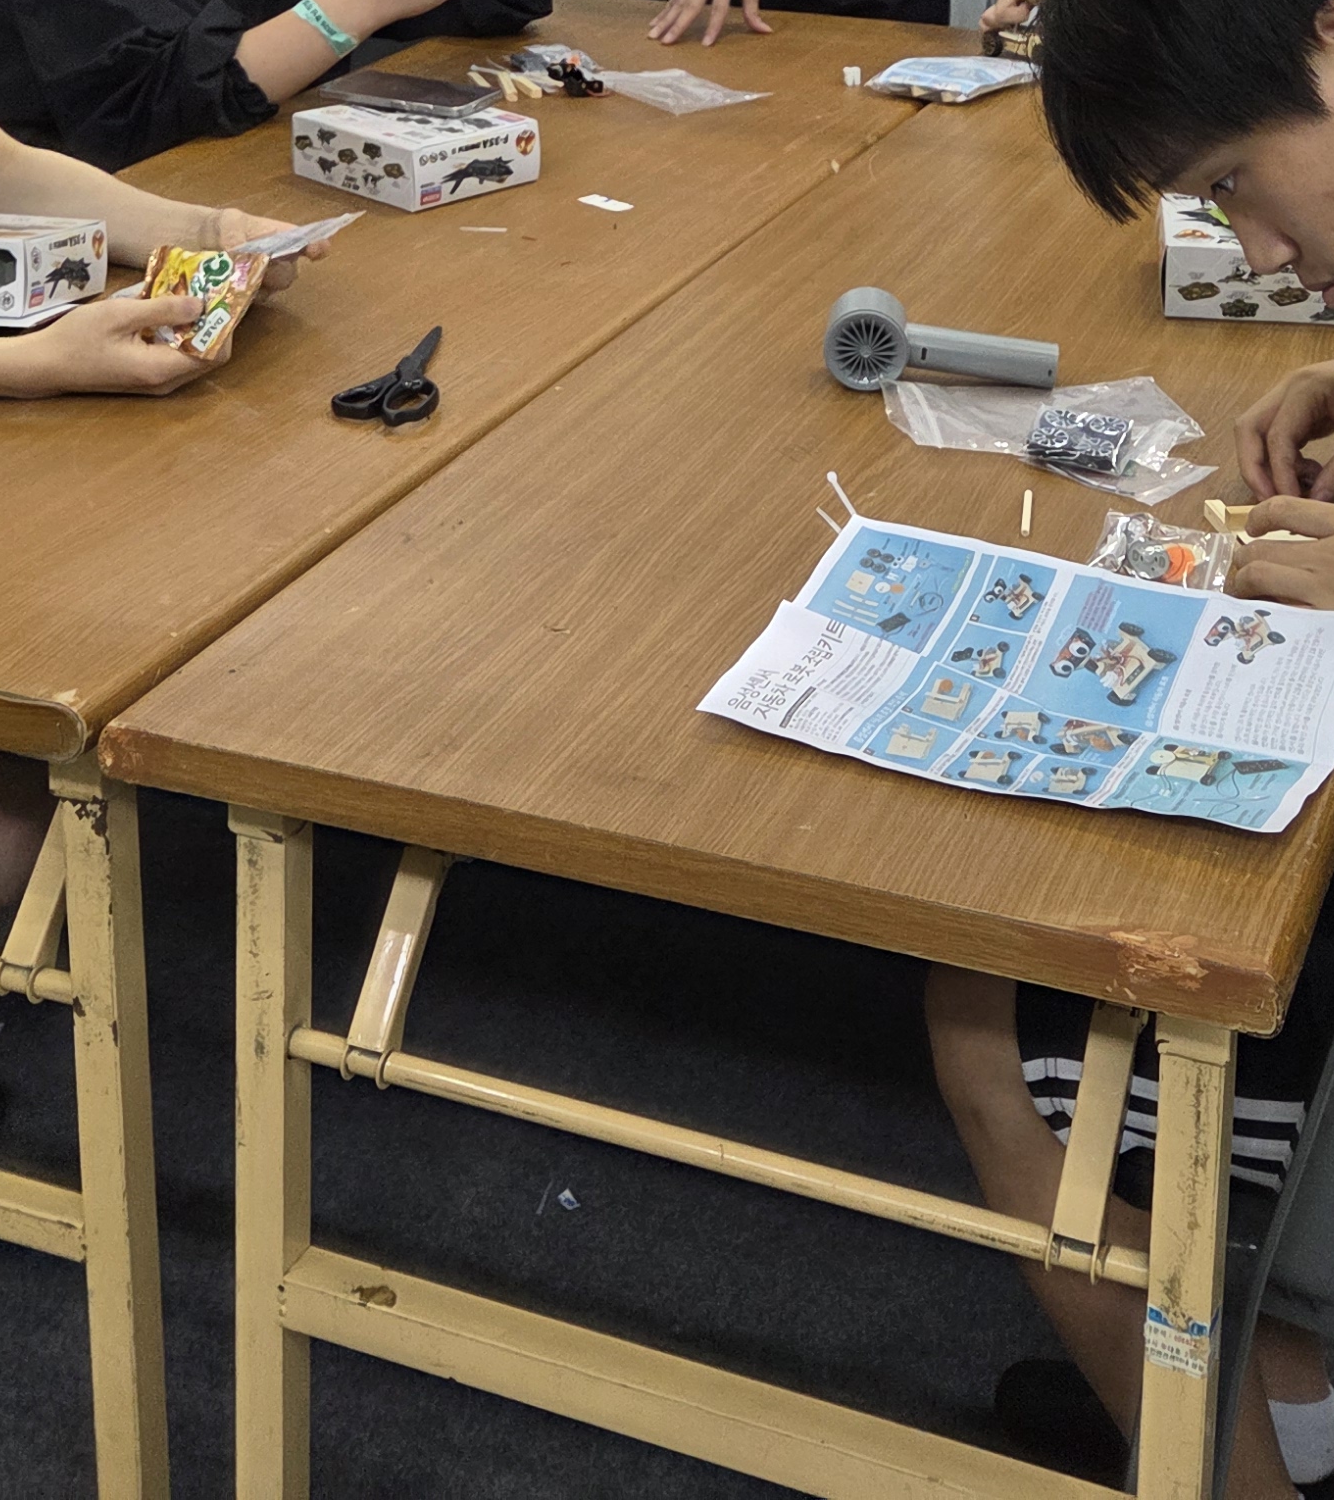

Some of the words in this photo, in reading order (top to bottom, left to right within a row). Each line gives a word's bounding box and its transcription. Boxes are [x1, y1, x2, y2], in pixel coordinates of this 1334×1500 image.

[753, 683, 797, 720] 자동차
[782, 661, 811, 686] 로봇
[801, 619, 848, 667] 조립키트
